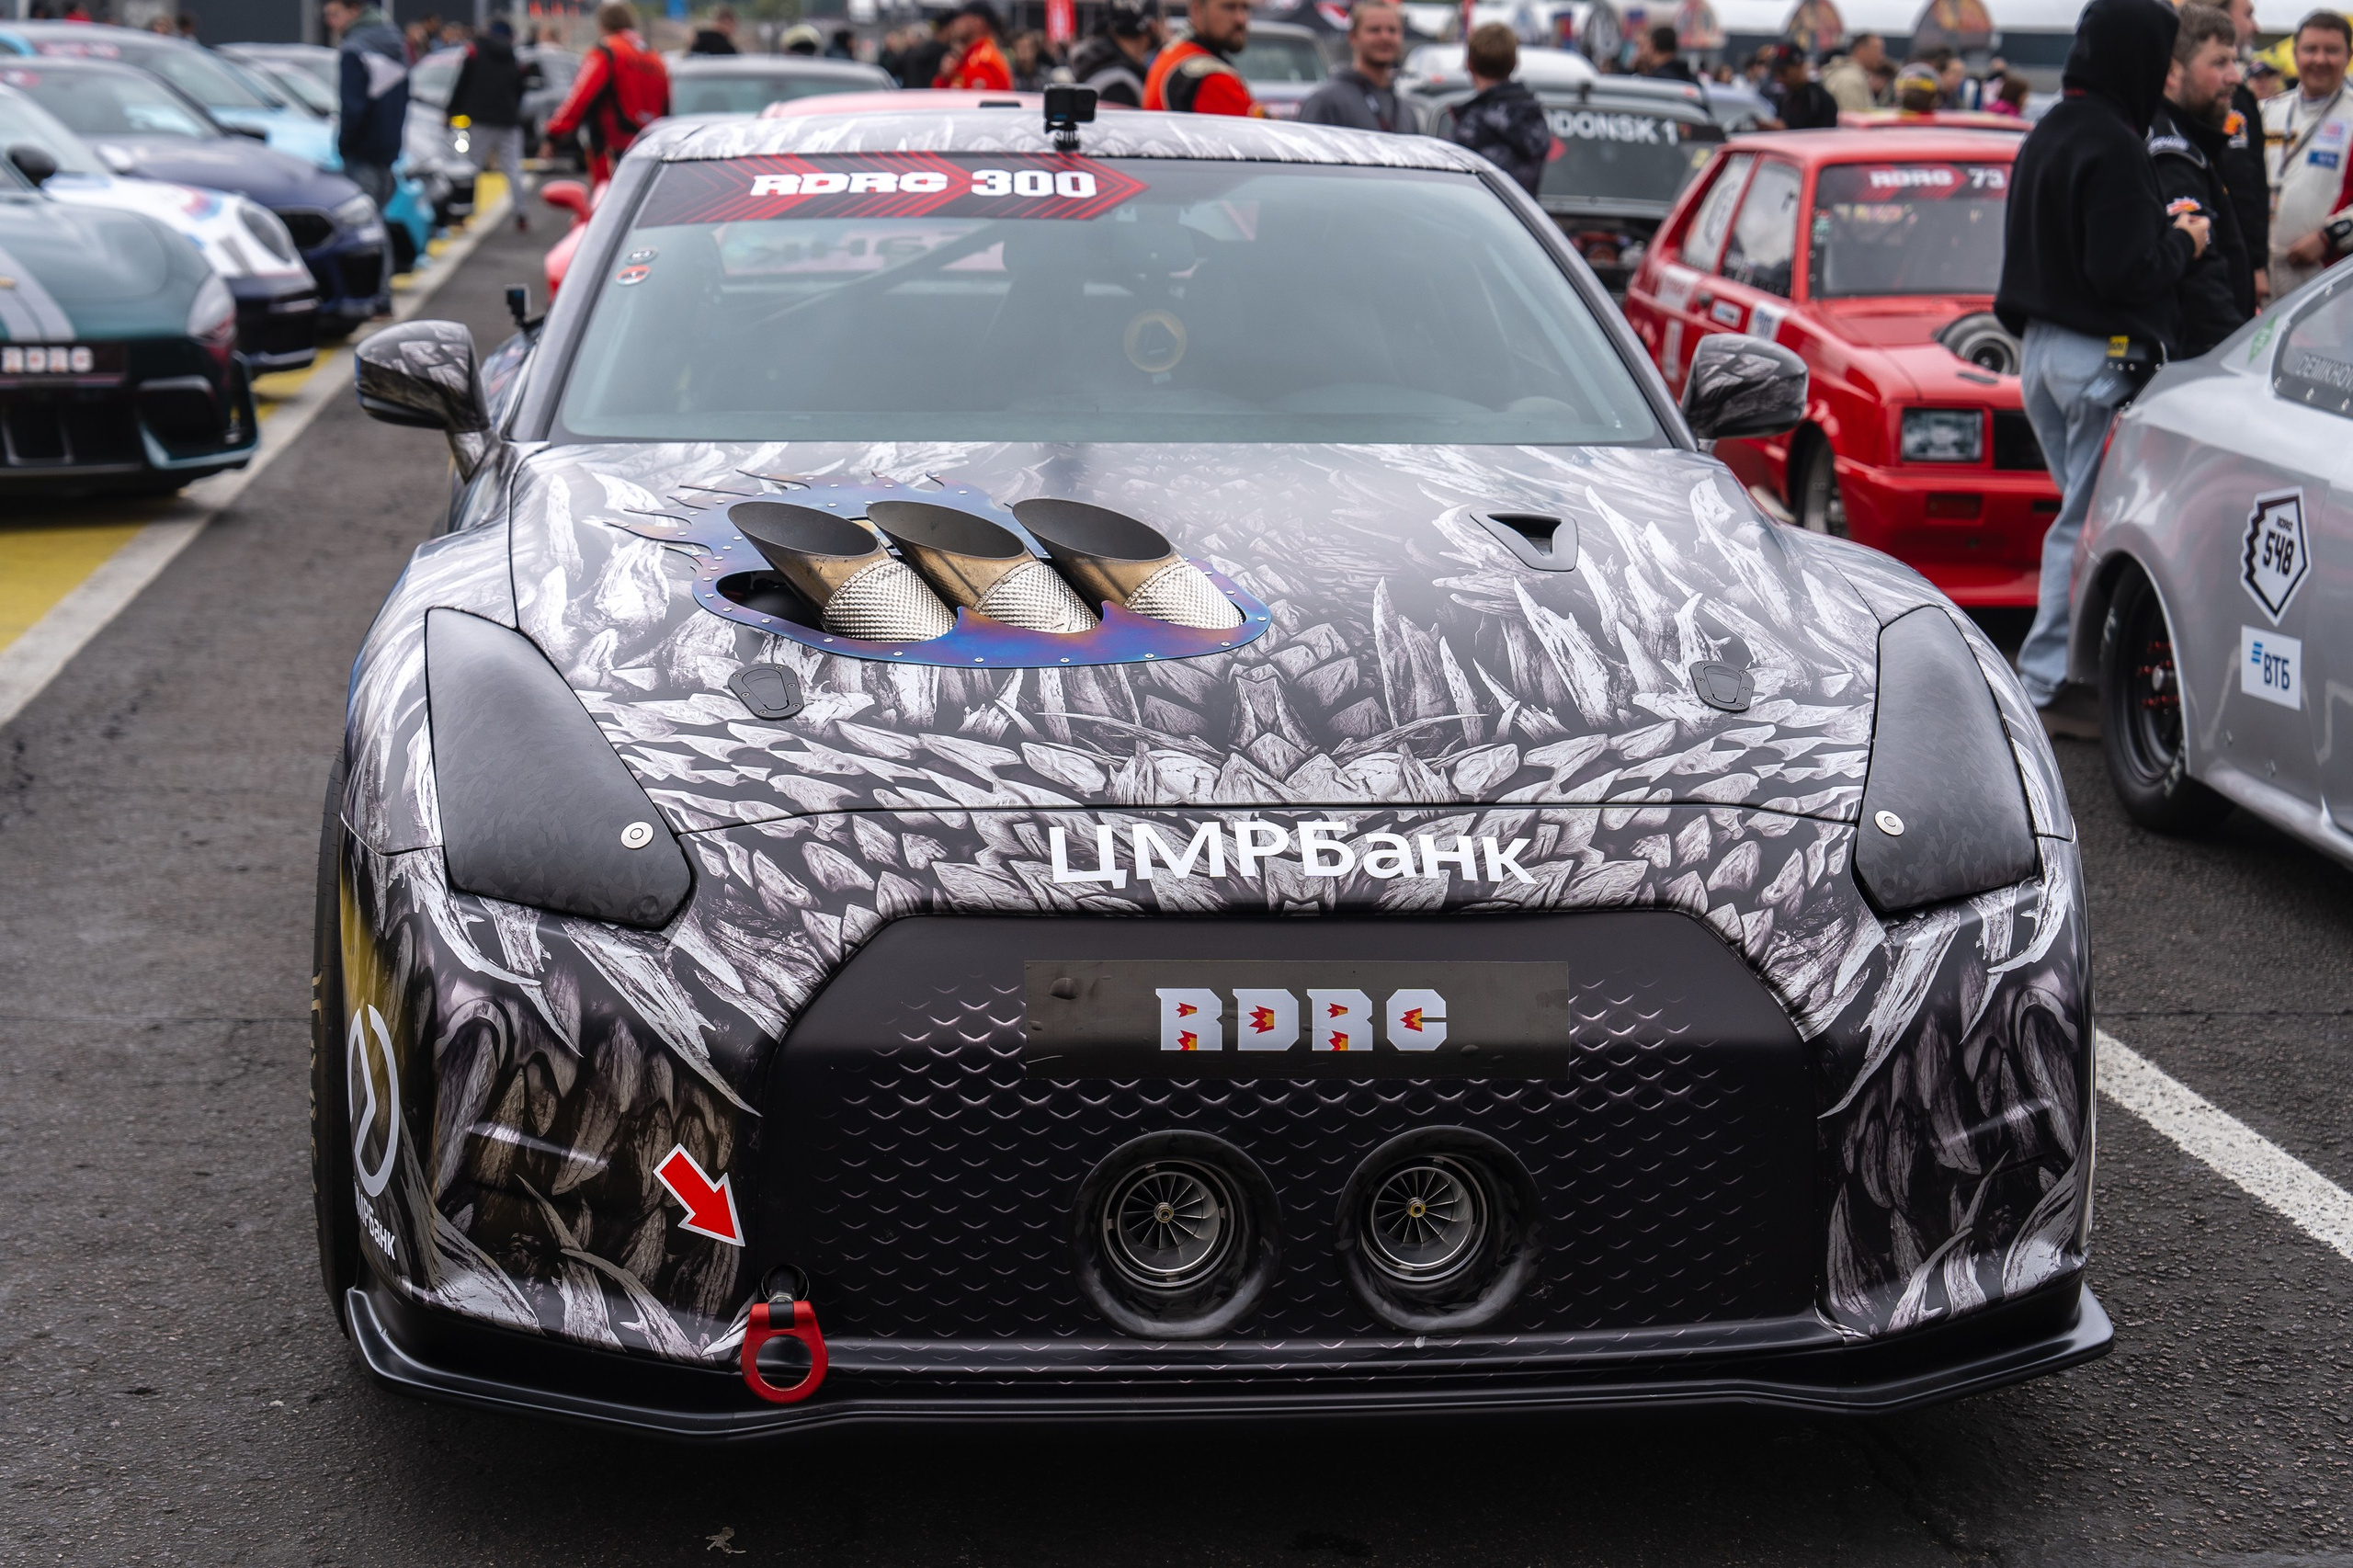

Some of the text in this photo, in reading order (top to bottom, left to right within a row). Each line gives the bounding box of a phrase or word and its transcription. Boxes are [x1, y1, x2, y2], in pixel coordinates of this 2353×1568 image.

[1543, 108, 1678, 146] DONSK 1
[749, 169, 1098, 199] RDRC 300
[2262, 528, 2295, 577] 548
[2263, 652, 2290, 691] ВТБ
[1048, 820, 1539, 889] ЦМРБанк
[1155, 988, 1448, 1051] RDRC
[353, 1176, 396, 1260] МРБанк
